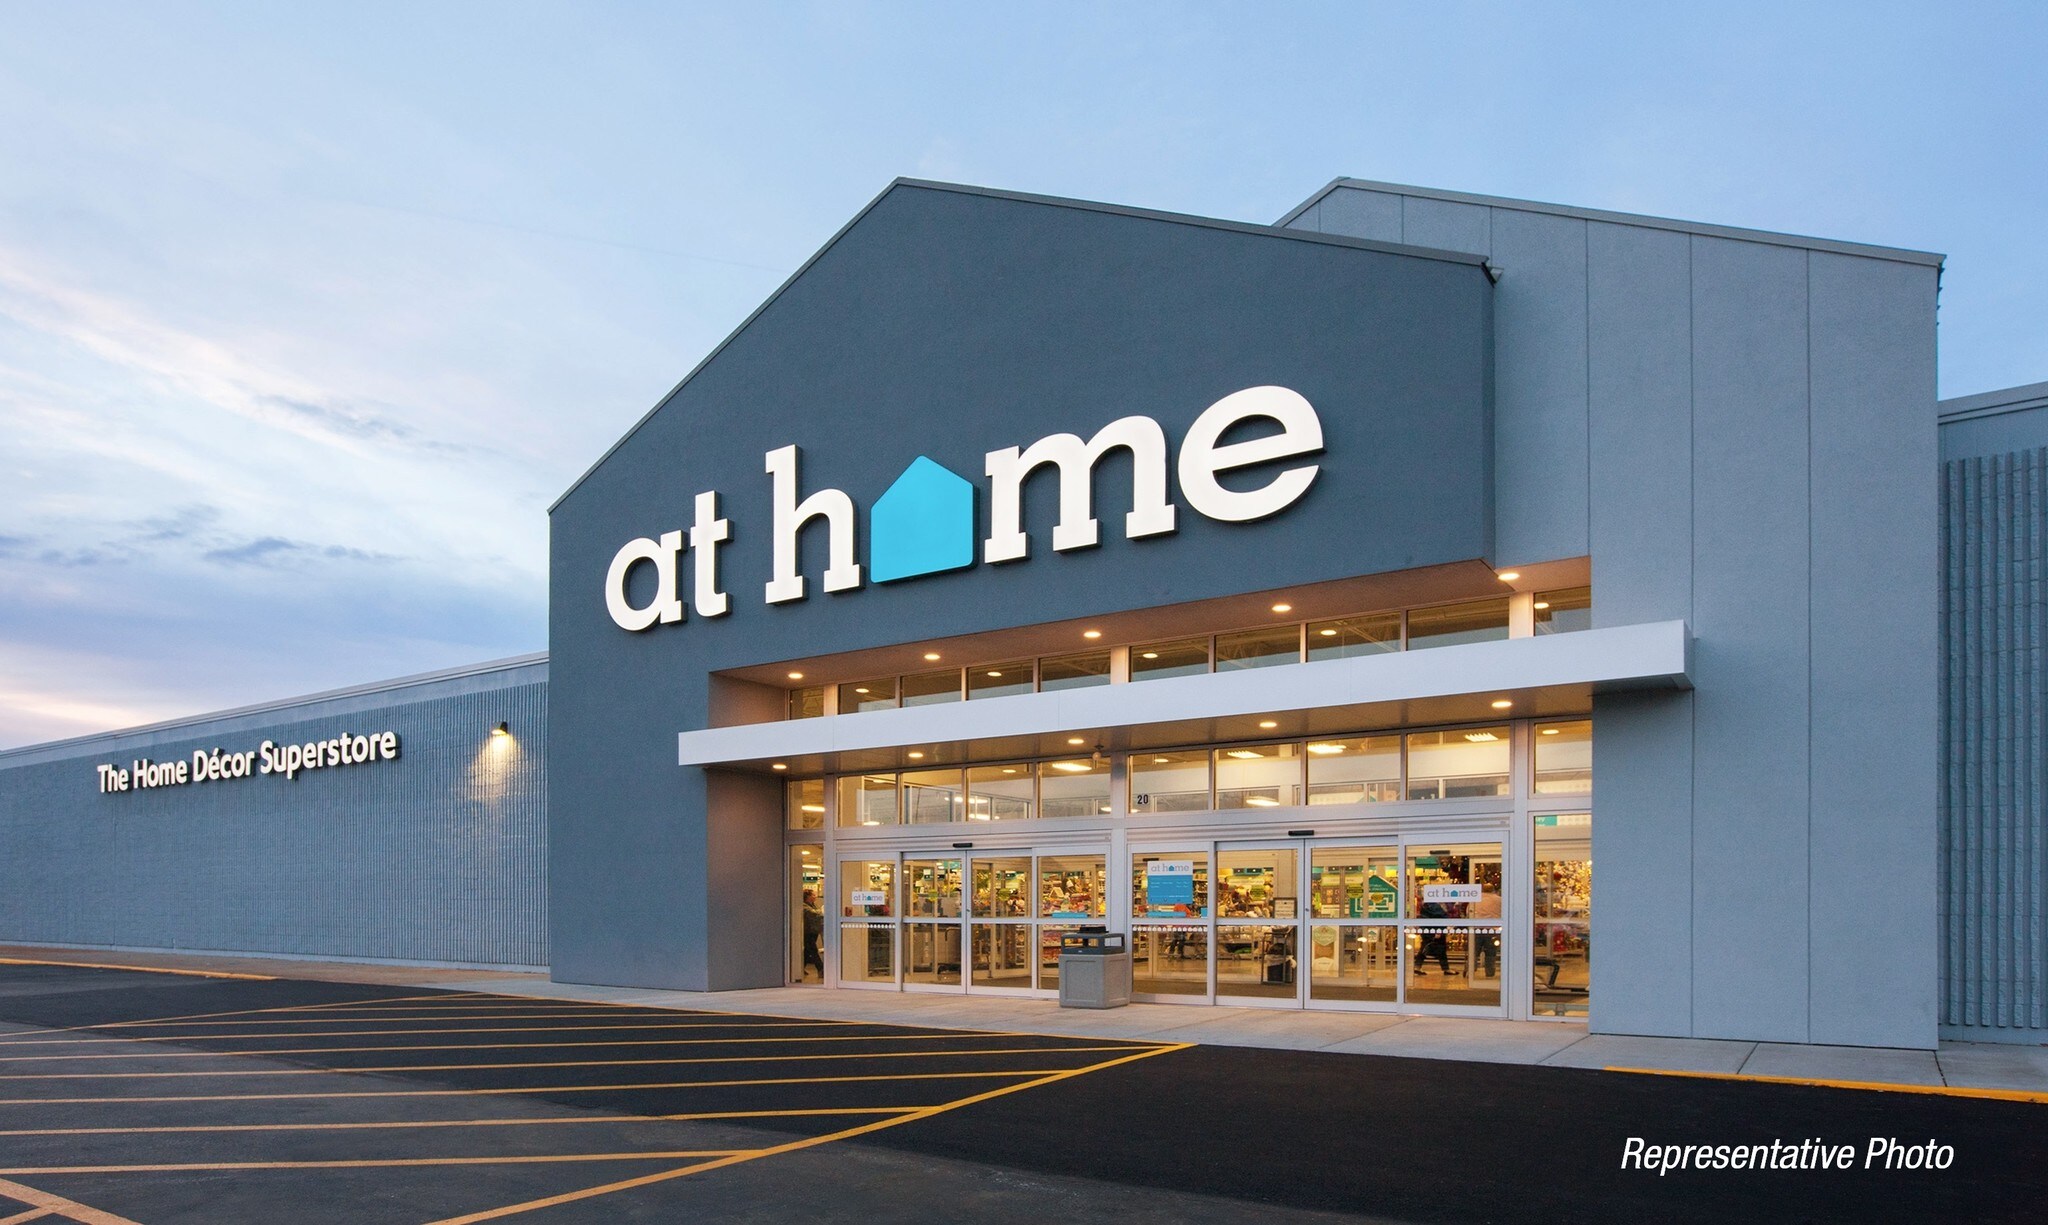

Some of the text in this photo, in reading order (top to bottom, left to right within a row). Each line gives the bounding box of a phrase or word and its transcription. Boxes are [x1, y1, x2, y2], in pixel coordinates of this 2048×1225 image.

[605, 490, 731, 632] at
[97, 731, 397, 793] The Home Décor Superstore
[1137, 794, 1149, 805] 20
[1151, 864, 1161, 872] at
[1427, 888, 1439, 898] at
